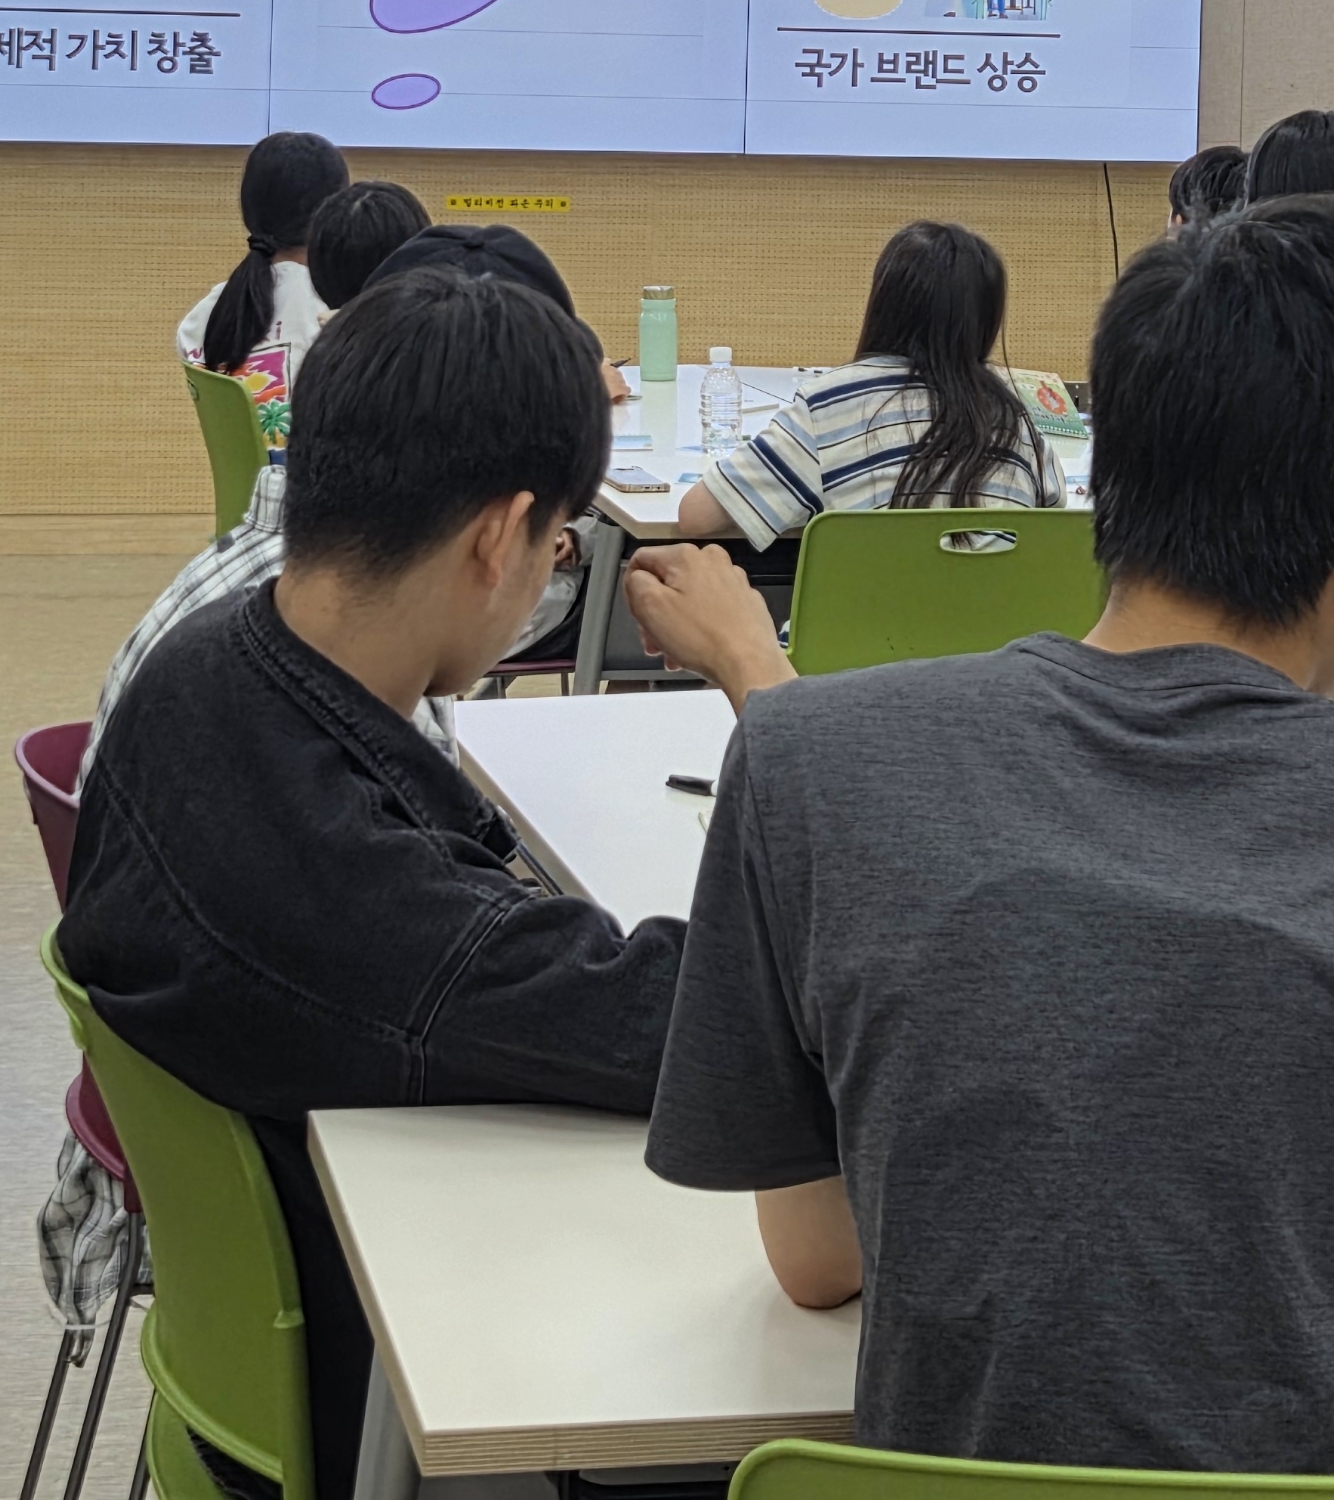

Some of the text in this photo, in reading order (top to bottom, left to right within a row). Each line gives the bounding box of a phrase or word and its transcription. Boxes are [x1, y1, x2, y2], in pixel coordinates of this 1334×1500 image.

[66, 29, 139, 71] 가치
[147, 31, 222, 74] 창출
[795, 48, 1046, 93] 국가 브랜드 상승
